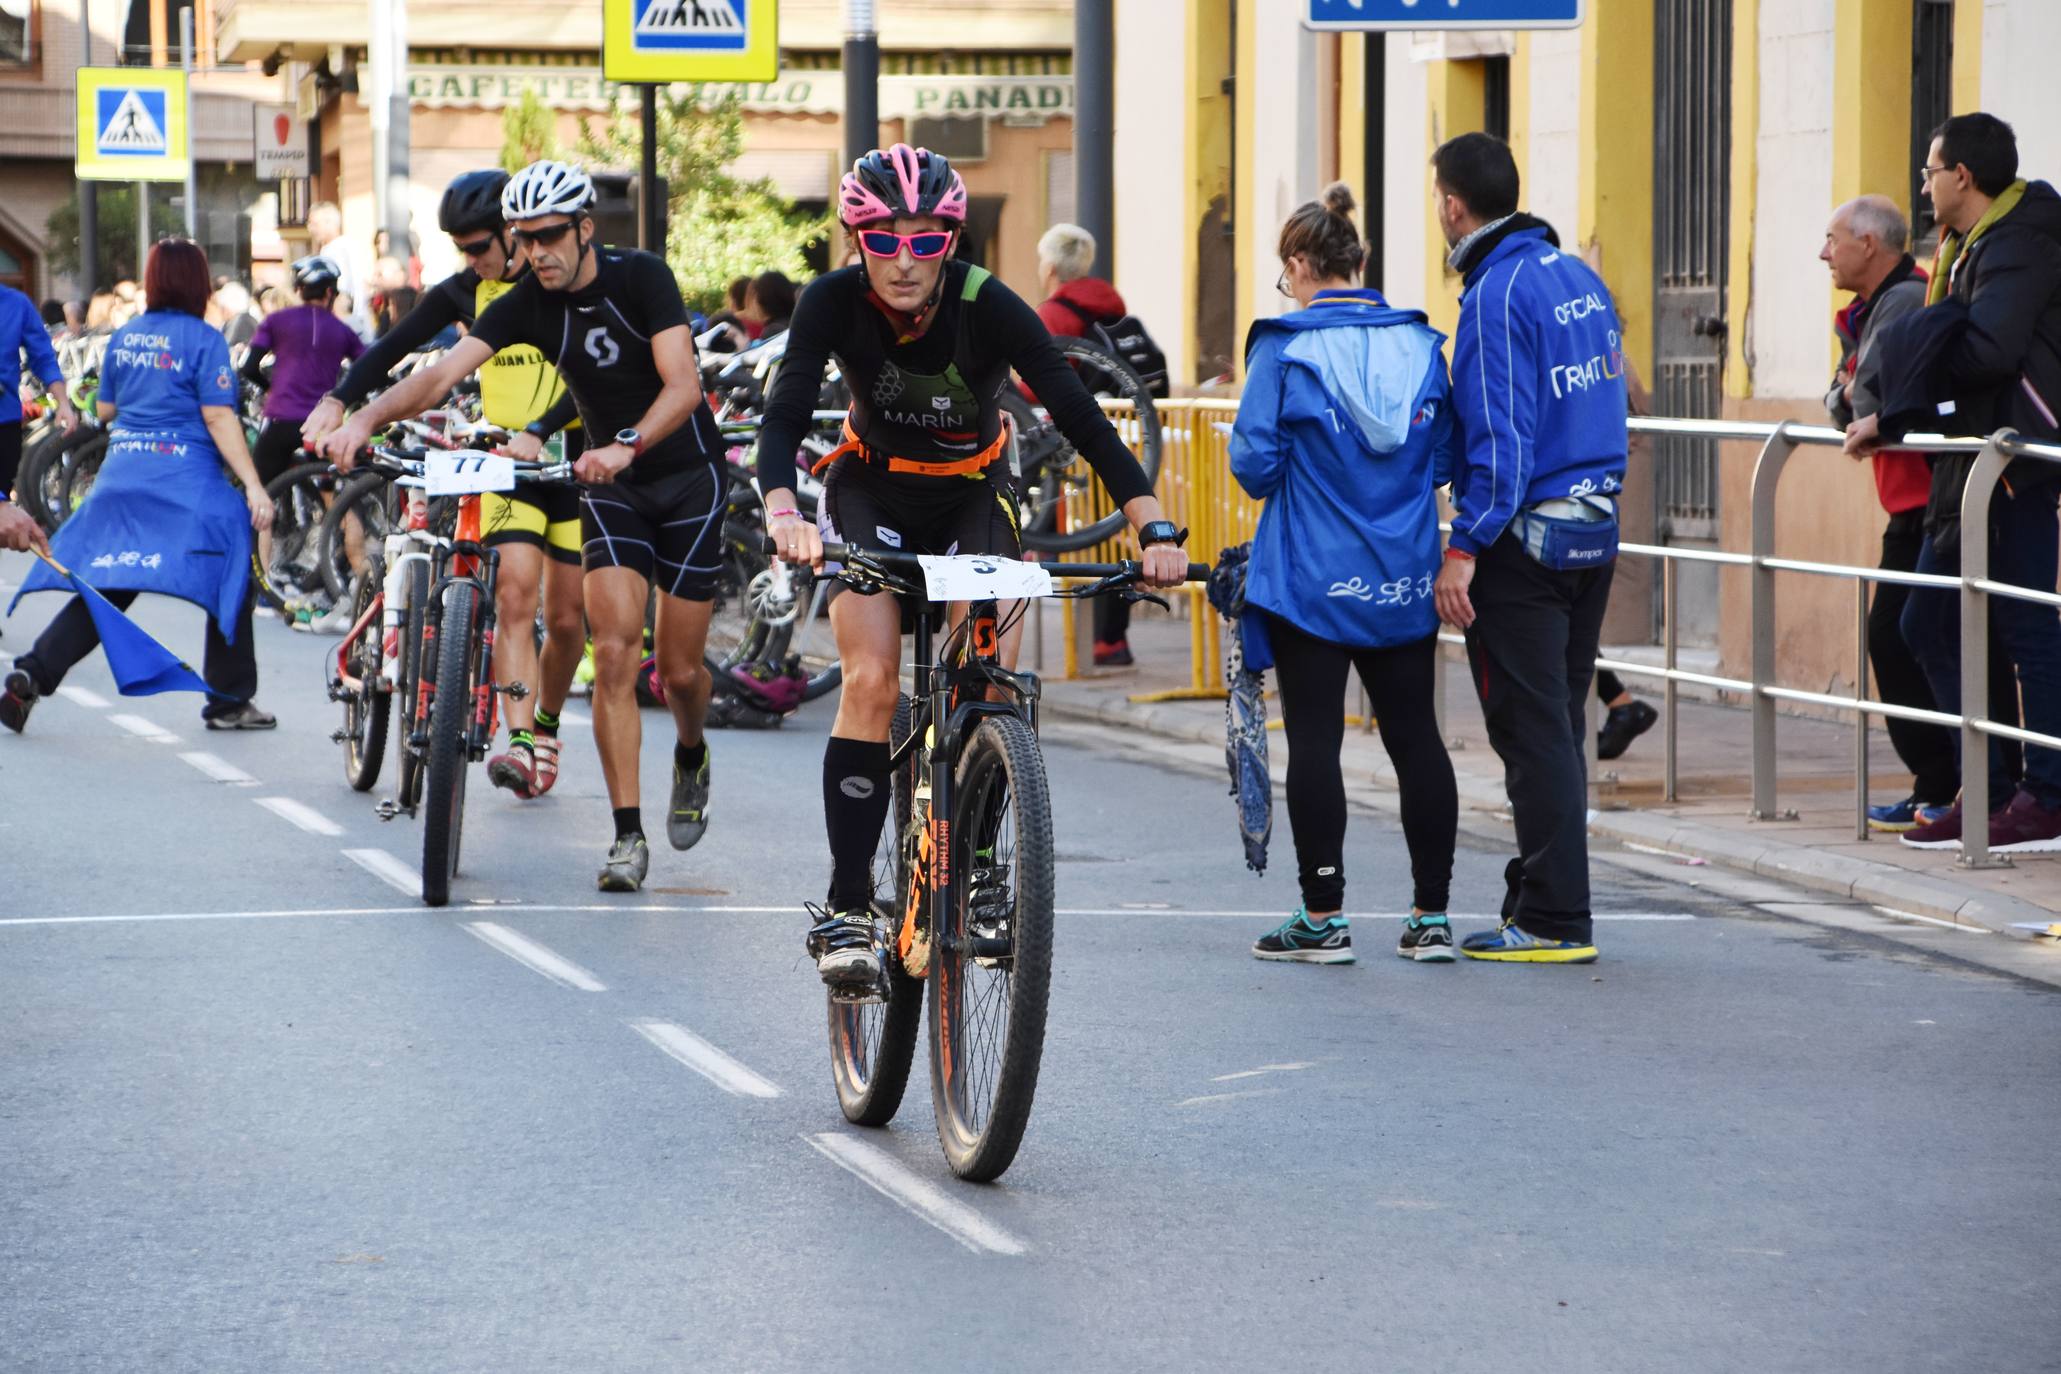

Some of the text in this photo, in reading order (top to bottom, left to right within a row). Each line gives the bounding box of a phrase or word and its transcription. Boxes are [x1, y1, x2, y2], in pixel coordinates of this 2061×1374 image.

[914, 84, 1074, 110] PANAD
[884, 410, 963, 428] MARÍN
[451, 456, 487, 474] 77
[939, 820, 950, 870] RHYTHM
